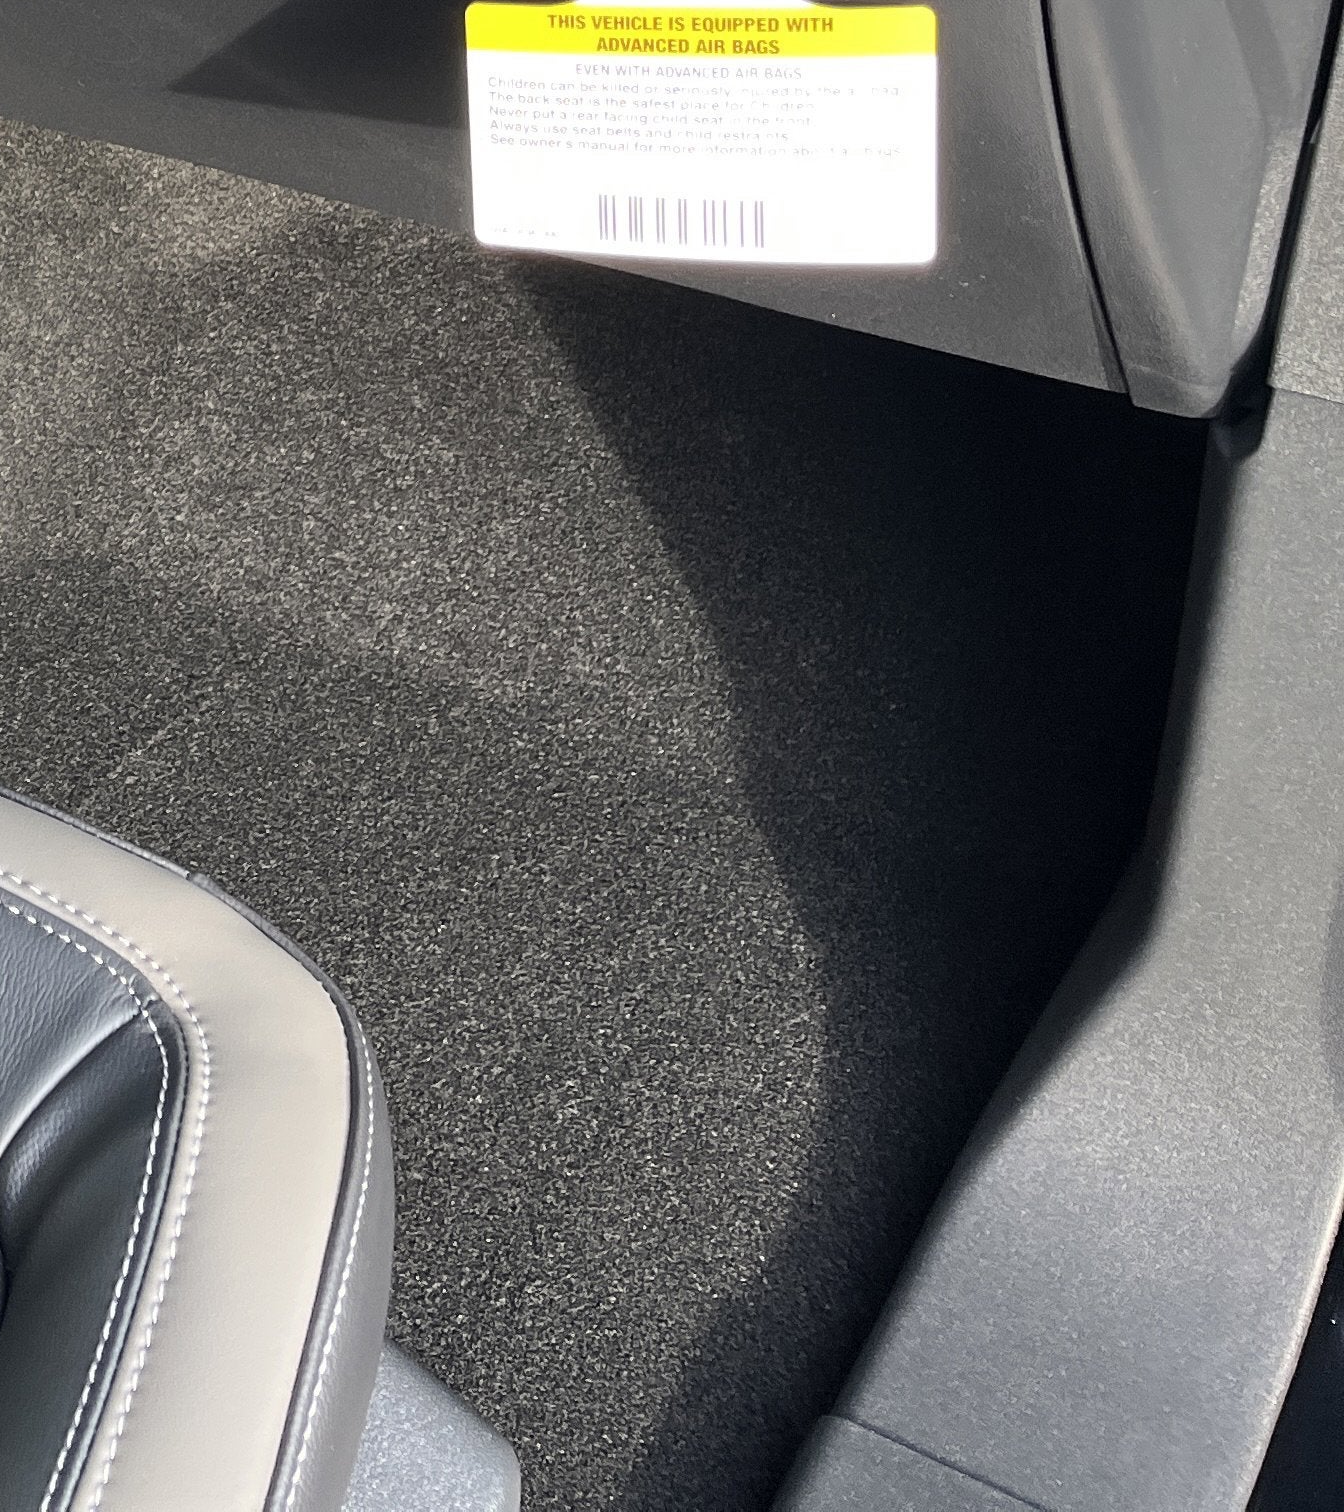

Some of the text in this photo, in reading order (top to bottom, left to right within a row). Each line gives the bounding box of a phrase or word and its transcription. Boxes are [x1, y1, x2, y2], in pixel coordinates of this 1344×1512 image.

[547, 14, 834, 33] THIS VEHICLE IS EQUIPPED WITH
[596, 37, 780, 55] ADVANCED AIR BAGS
[575, 63, 802, 80] EVEN WITH ADVANCED AIR BAGS
[488, 76, 546, 91] Children
[550, 81, 575, 92] can
[580, 80, 597, 92] be
[489, 91, 514, 102] The
[518, 93, 550, 105] back
[555, 96, 584, 106] seat
[605, 97, 627, 108] the
[489, 105, 528, 117] Never
[532, 110, 555, 120] put
[490, 119, 539, 134] Always
[490, 133, 515, 145] See
